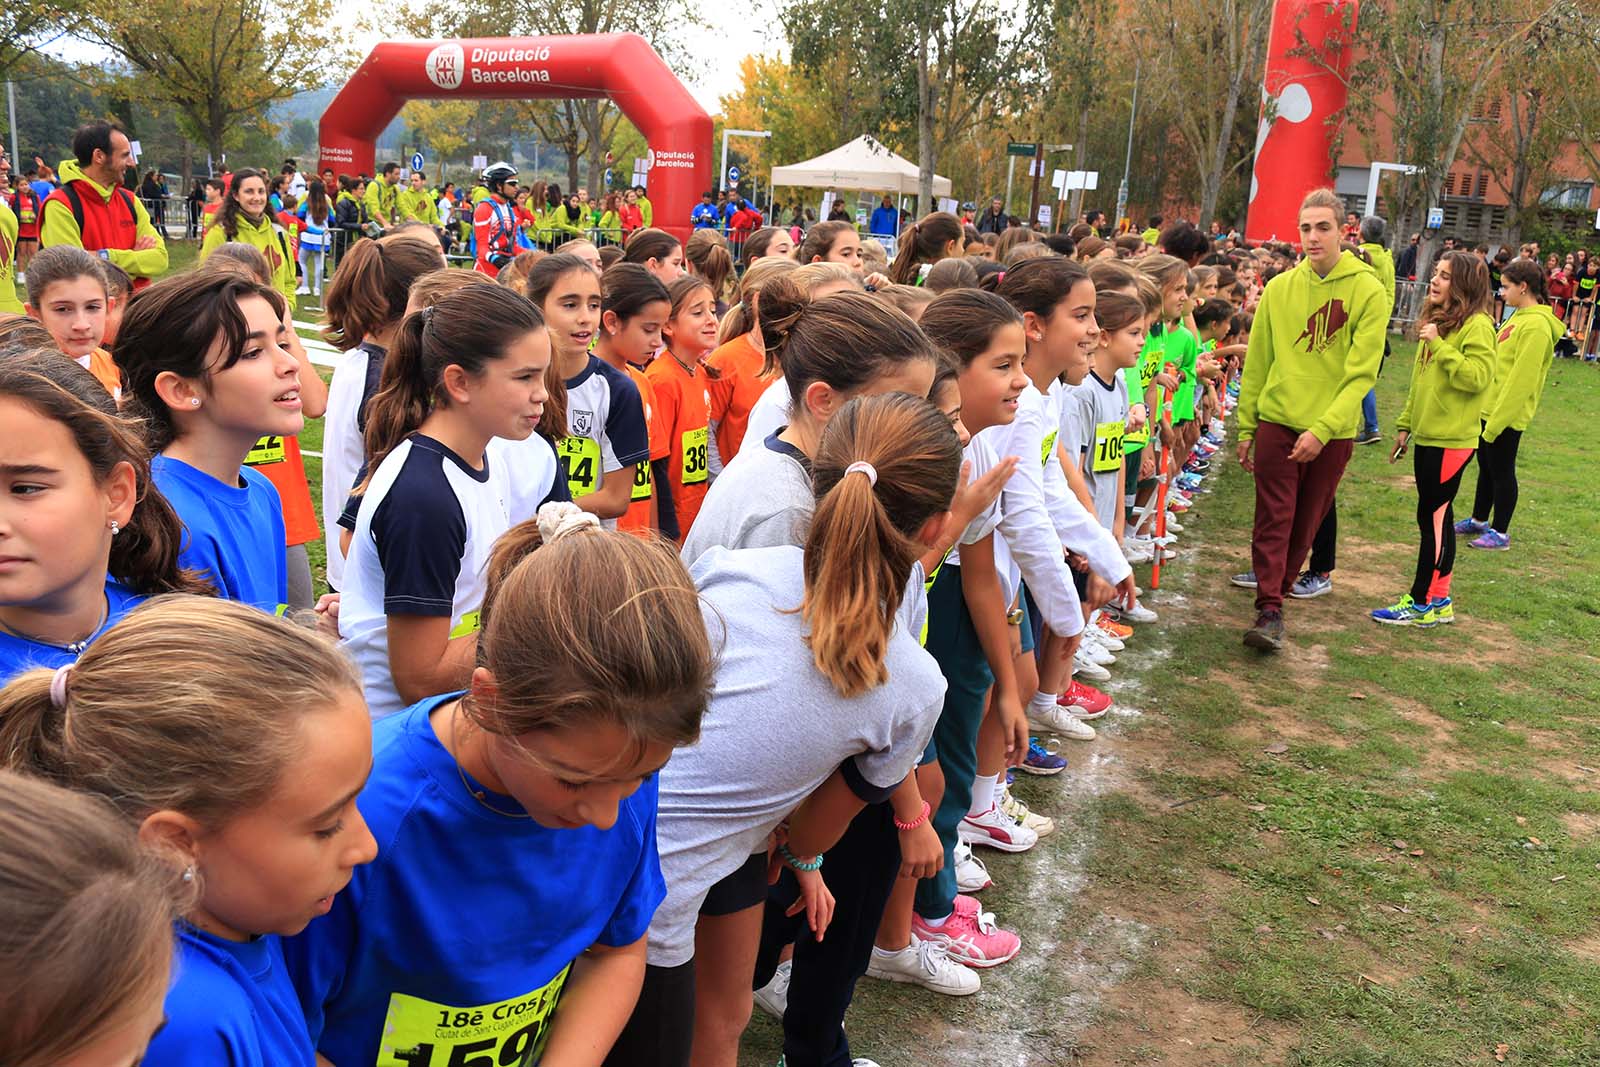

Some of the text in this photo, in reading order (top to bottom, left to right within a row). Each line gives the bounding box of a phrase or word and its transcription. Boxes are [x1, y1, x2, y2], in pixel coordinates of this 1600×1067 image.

[471, 46, 551, 66] Diputació
[471, 67, 551, 84] Barcelona
[656, 151, 695, 160] Diputació
[656, 160, 695, 168] Barcelona
[685, 444, 708, 474] 38
[492, 997, 537, 1020] Cros
[434, 1029, 459, 1039] Ciutat
[460, 1028, 471, 1037] de
